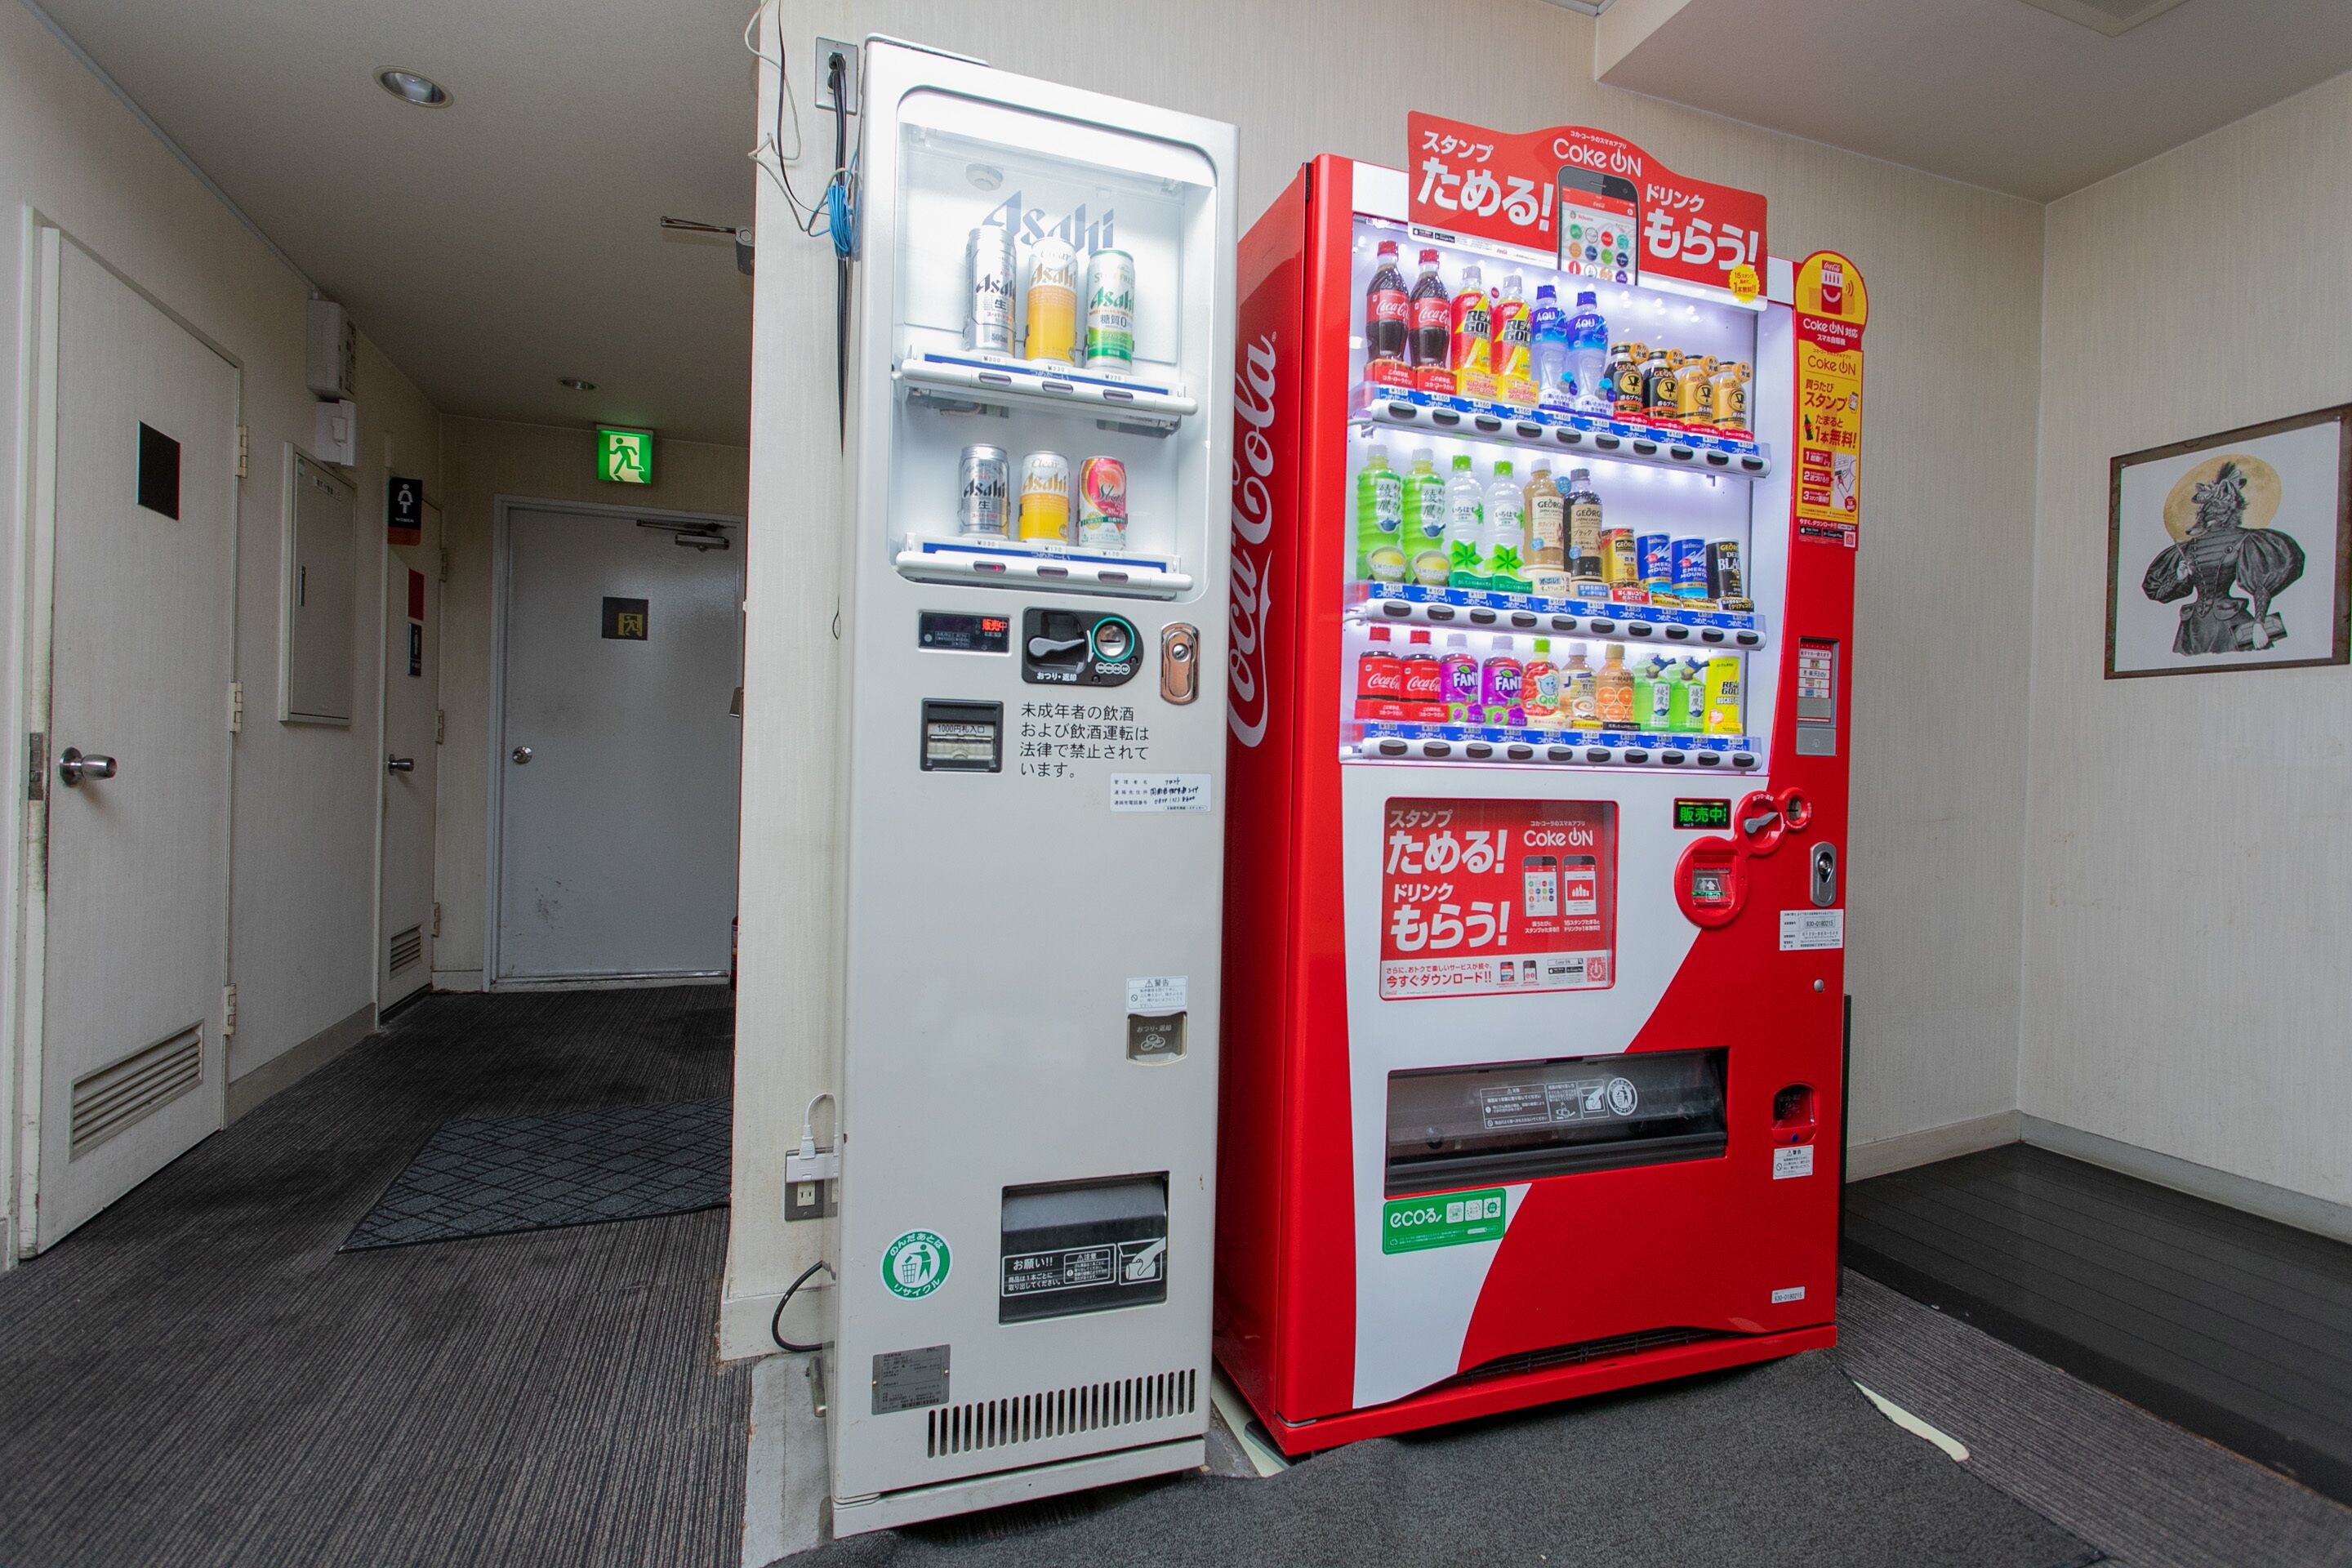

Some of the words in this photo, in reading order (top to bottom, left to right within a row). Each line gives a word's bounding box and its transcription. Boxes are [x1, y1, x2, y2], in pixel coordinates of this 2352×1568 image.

[1422, 131, 1494, 163] スタンプ
[1553, 138, 1607, 169] Coke
[1610, 149, 1642, 177] ON
[1417, 157, 1554, 232] ためる!
[1646, 182, 1705, 212] ドリンク
[1643, 207, 1760, 270] もらう!
[995, 299, 1007, 310] 生
[1100, 314, 1127, 327] 糖質0
[1802, 318, 1829, 332] Coke
[1829, 321, 1844, 336] ON
[1845, 327, 1859, 339] 対応
[1807, 354, 1837, 372] Coke
[1838, 359, 1856, 376] ON
[1806, 379, 1834, 393] 買うたび
[1804, 392, 1848, 412] スタンプ
[1815, 414, 1843, 428] たまると
[1815, 425, 1857, 448] 1本無料!
[1031, 458, 1059, 469] Clear
[1022, 472, 1067, 493] Asahi
[1803, 471, 1810, 479] 2
[964, 477, 1005, 499] Asahi
[1803, 490, 1810, 501] 3
[978, 501, 991, 510] 生
[982, 618, 1007, 631] 販売中
[1021, 702, 1134, 722] 未成年者の飲酒
[937, 724, 986, 734] 1000円札入口
[1021, 724, 1150, 742] および飲酒運転は
[1020, 742, 1148, 760] 法律で禁止されて
[1021, 761, 1076, 778] います。
[1389, 808, 1453, 828] スタンプ
[1680, 806, 1723, 822] 販売中
[1523, 831, 1566, 847] Coke
[1568, 827, 1593, 847] ON
[1386, 829, 1508, 875] ためる!
[1394, 883, 1454, 902] ドリンク
[1391, 901, 1511, 951] もらう!
[1386, 971, 1492, 989] 今すぐダウンロード!!
[889, 1233, 944, 1257] のんだあとは
[893, 1278, 940, 1296] リサイクル
